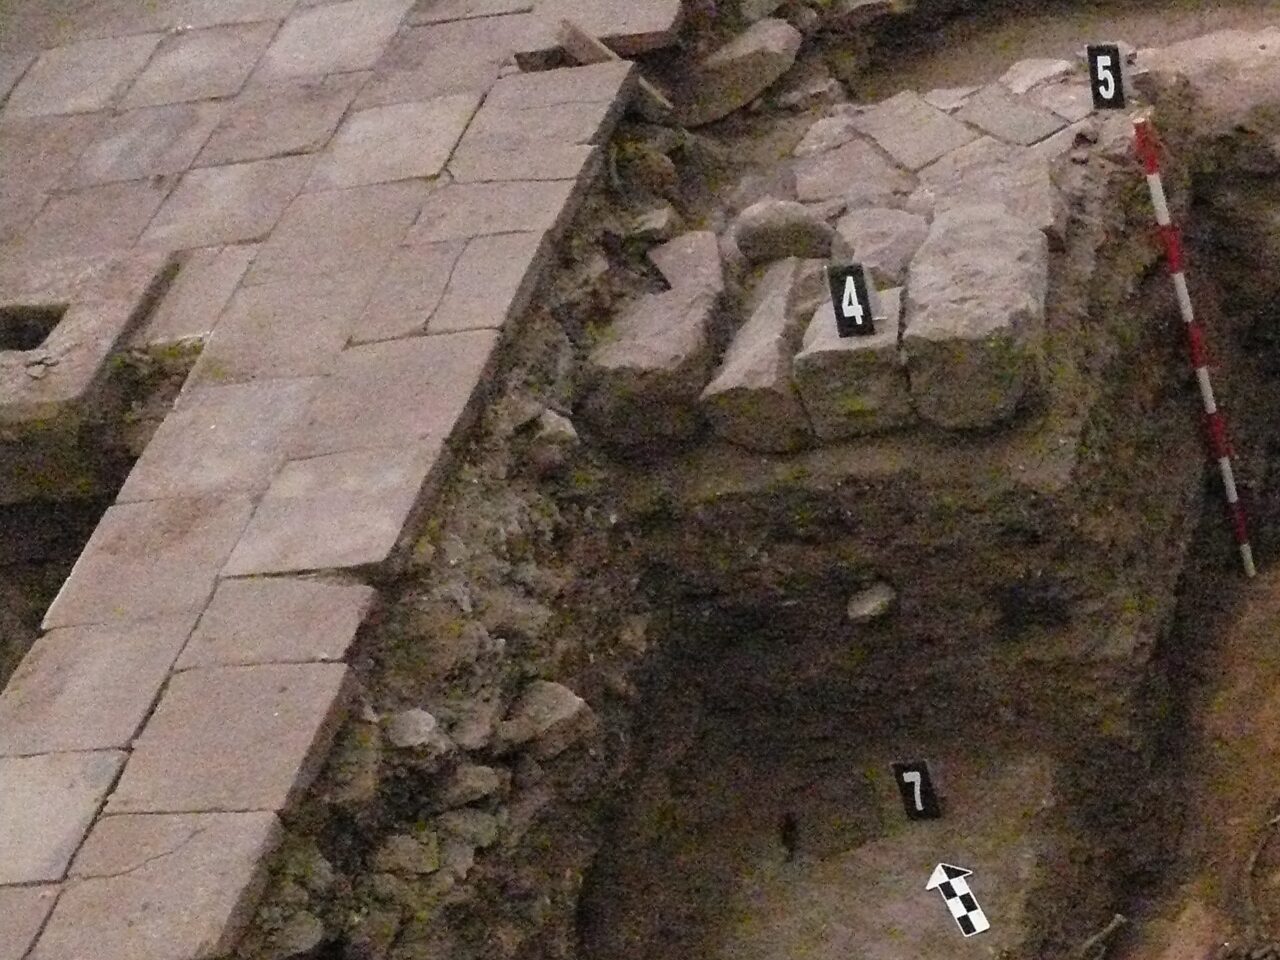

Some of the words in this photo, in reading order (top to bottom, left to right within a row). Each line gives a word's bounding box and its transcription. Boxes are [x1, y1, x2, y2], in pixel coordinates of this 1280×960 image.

[1097, 56, 1115, 99] 5
[842, 276, 863, 325] 4
[903, 771, 924, 810] 7
